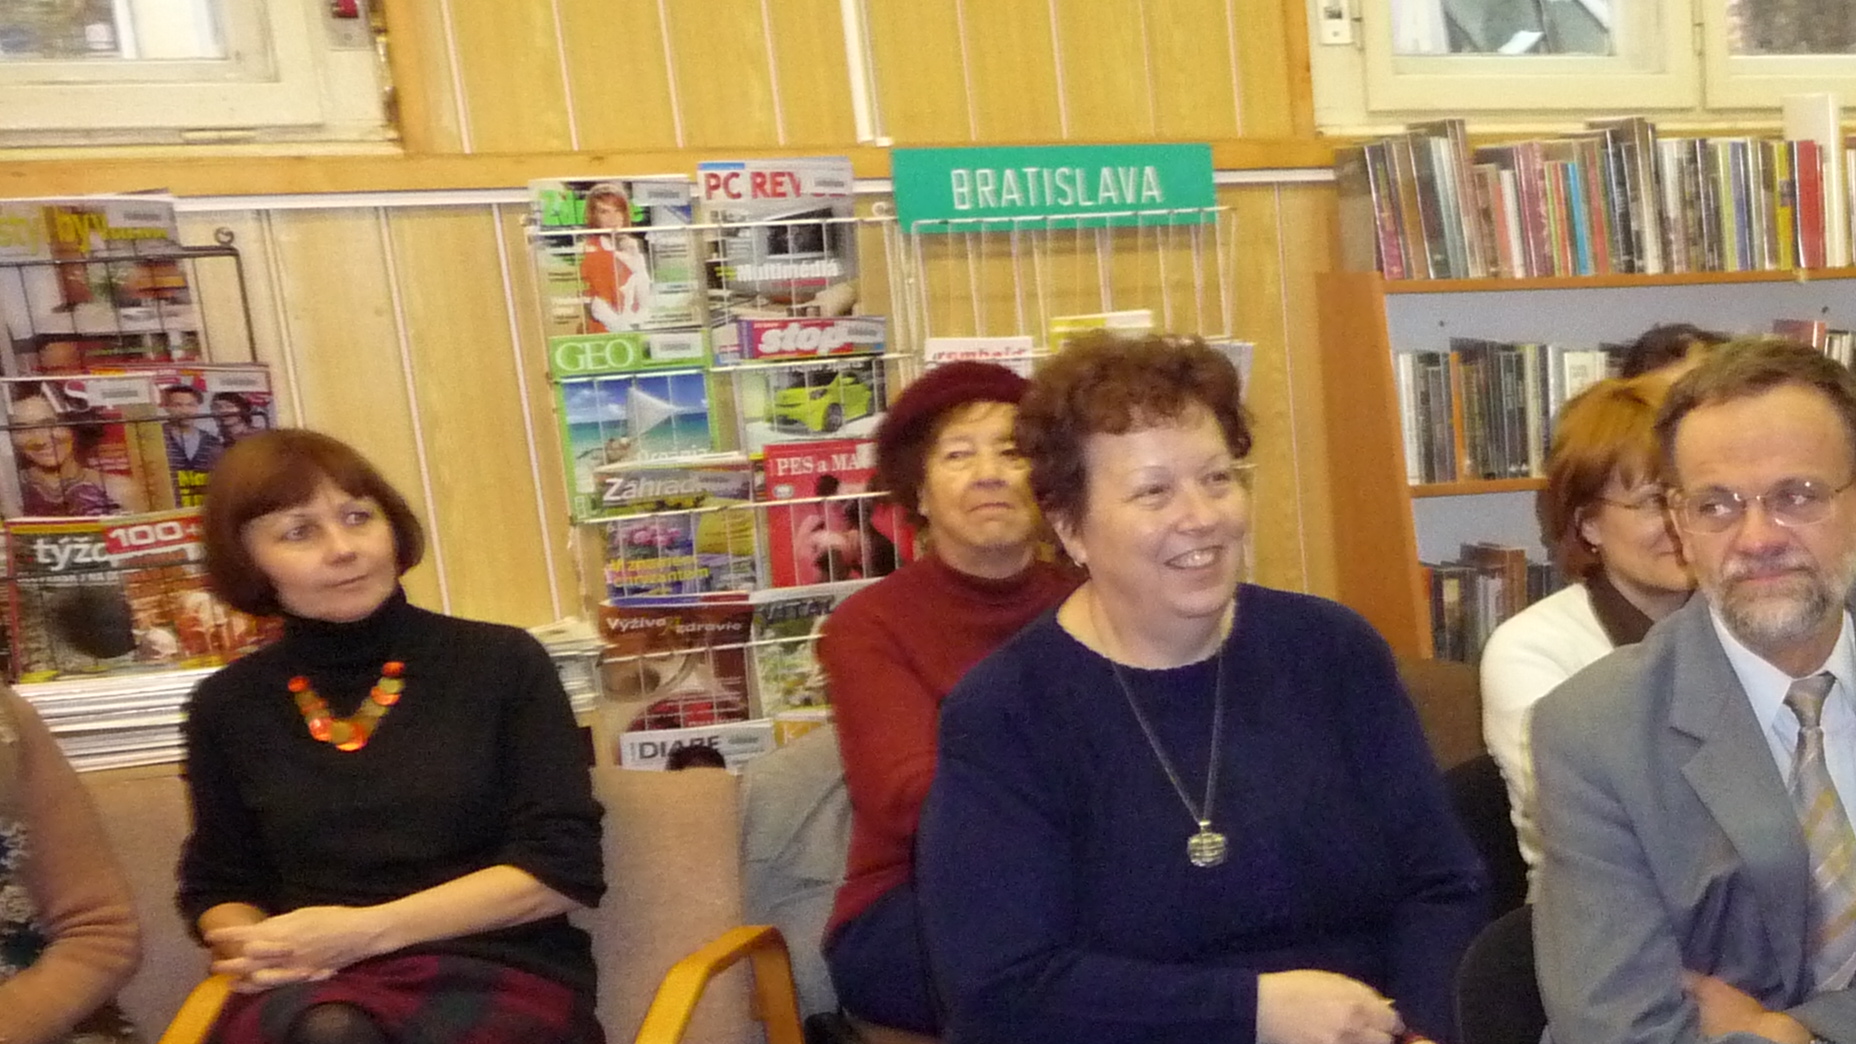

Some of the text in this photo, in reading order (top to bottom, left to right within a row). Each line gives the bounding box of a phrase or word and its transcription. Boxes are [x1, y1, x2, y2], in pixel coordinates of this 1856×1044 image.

[704, 171, 742, 200] PC
[950, 166, 1164, 210] BRATISLAVA
[555, 340, 634, 370] GEO
[777, 453, 859, 475] PES a MA
